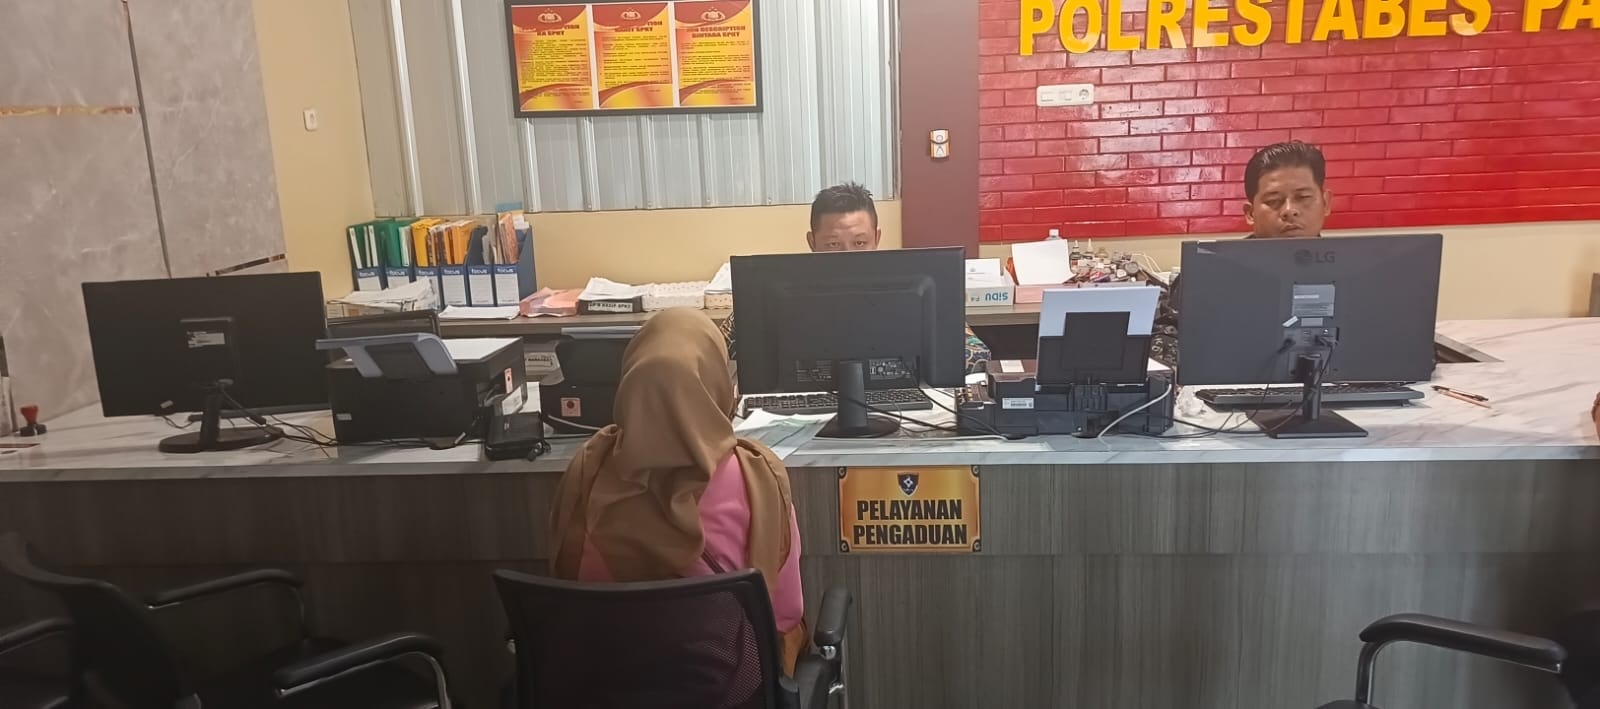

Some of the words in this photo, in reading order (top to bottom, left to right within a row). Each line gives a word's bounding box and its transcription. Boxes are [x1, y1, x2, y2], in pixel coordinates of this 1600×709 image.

[1019, 0, 1492, 56] POLRESTABES
[1315, 251, 1336, 264] LG
[857, 499, 962, 520] PELAYANAN
[853, 524, 967, 544] PENGADUAN
